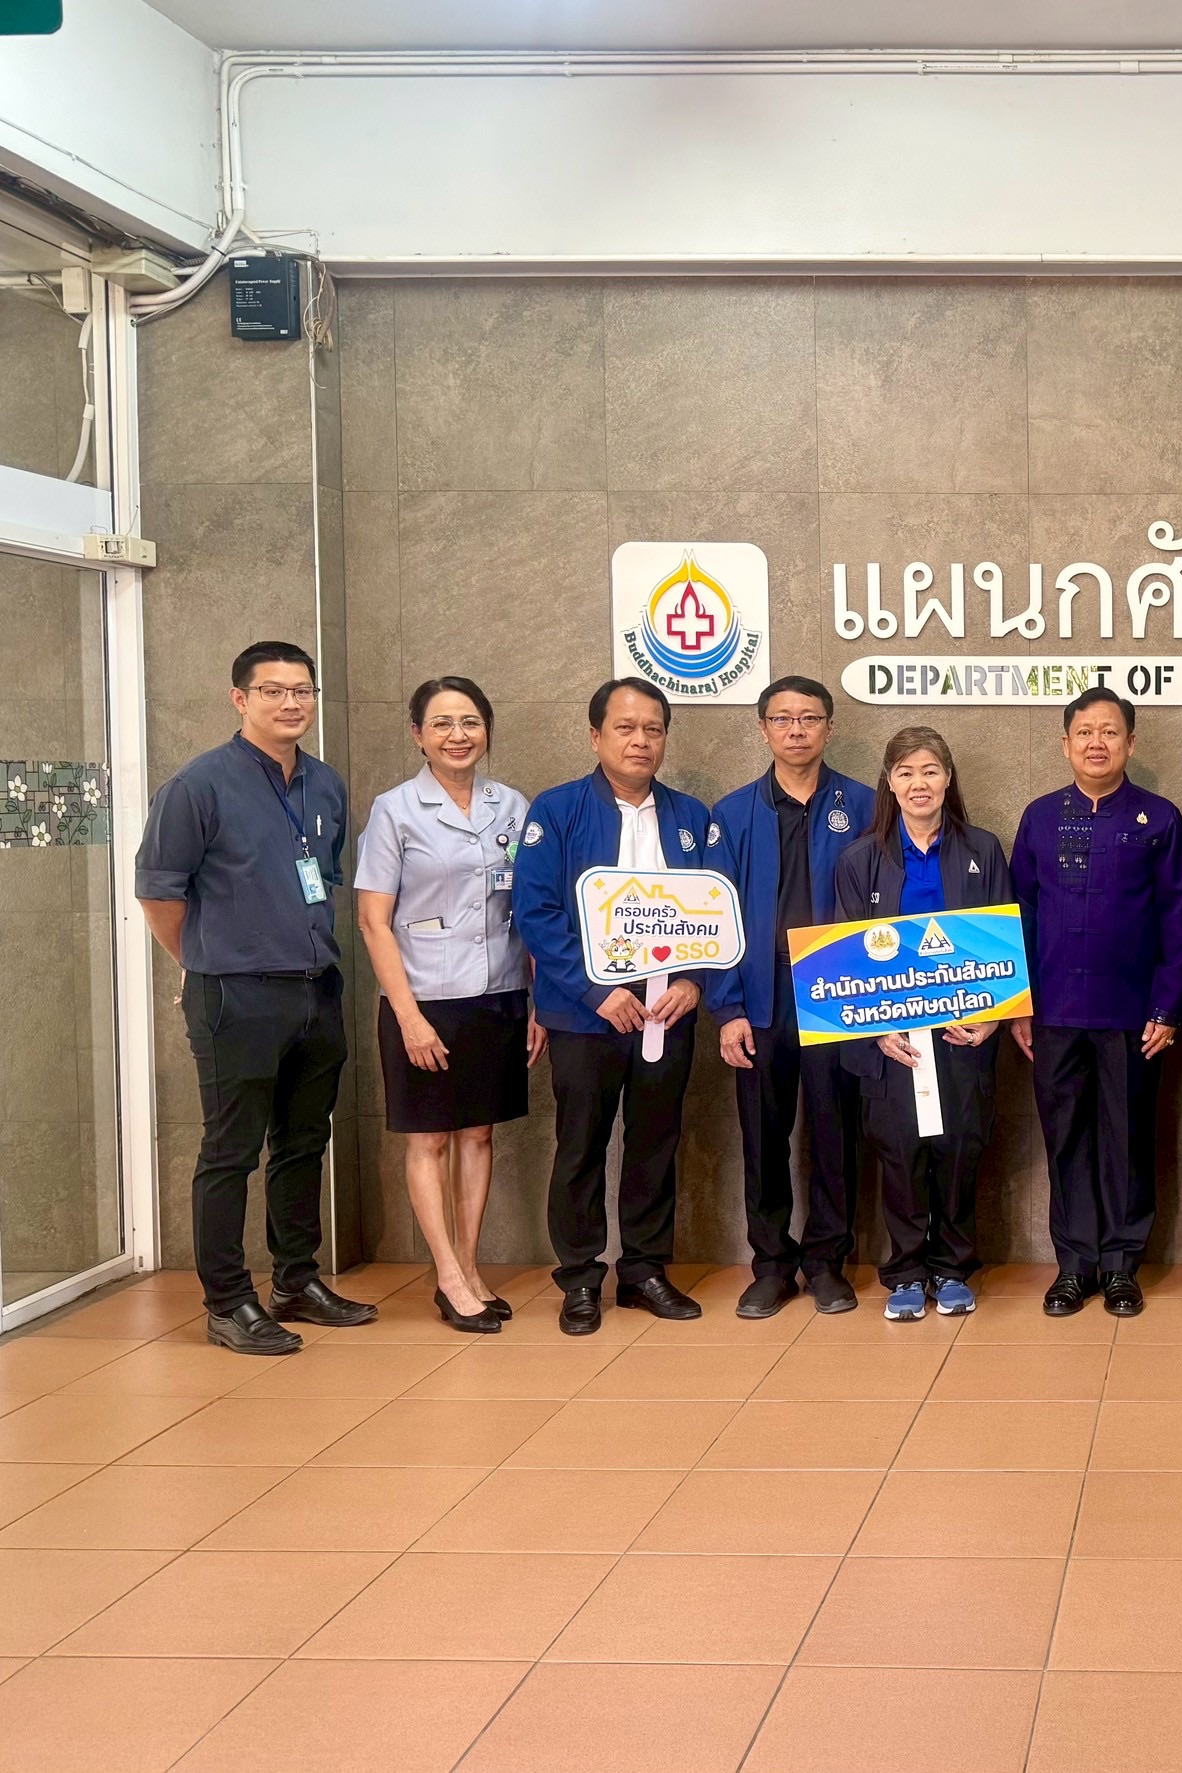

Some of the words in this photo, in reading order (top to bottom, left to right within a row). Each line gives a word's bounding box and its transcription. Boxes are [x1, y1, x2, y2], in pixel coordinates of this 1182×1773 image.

[624, 631, 718, 694] Buddhachinaraj
[718, 633, 759, 687] Hospital
[869, 664, 1112, 696] DEPARTMENT
[1127, 664, 1174, 696] OF
[614, 904, 677, 918] ครอบครัว
[623, 919, 719, 936] ประกันสังคม
[642, 947, 648, 965] I
[675, 940, 720, 961] SSO
[810, 959, 1014, 1001] สำนักงานประกันสังคม
[840, 989, 992, 1025] จังหวัดพิษณุโลก
